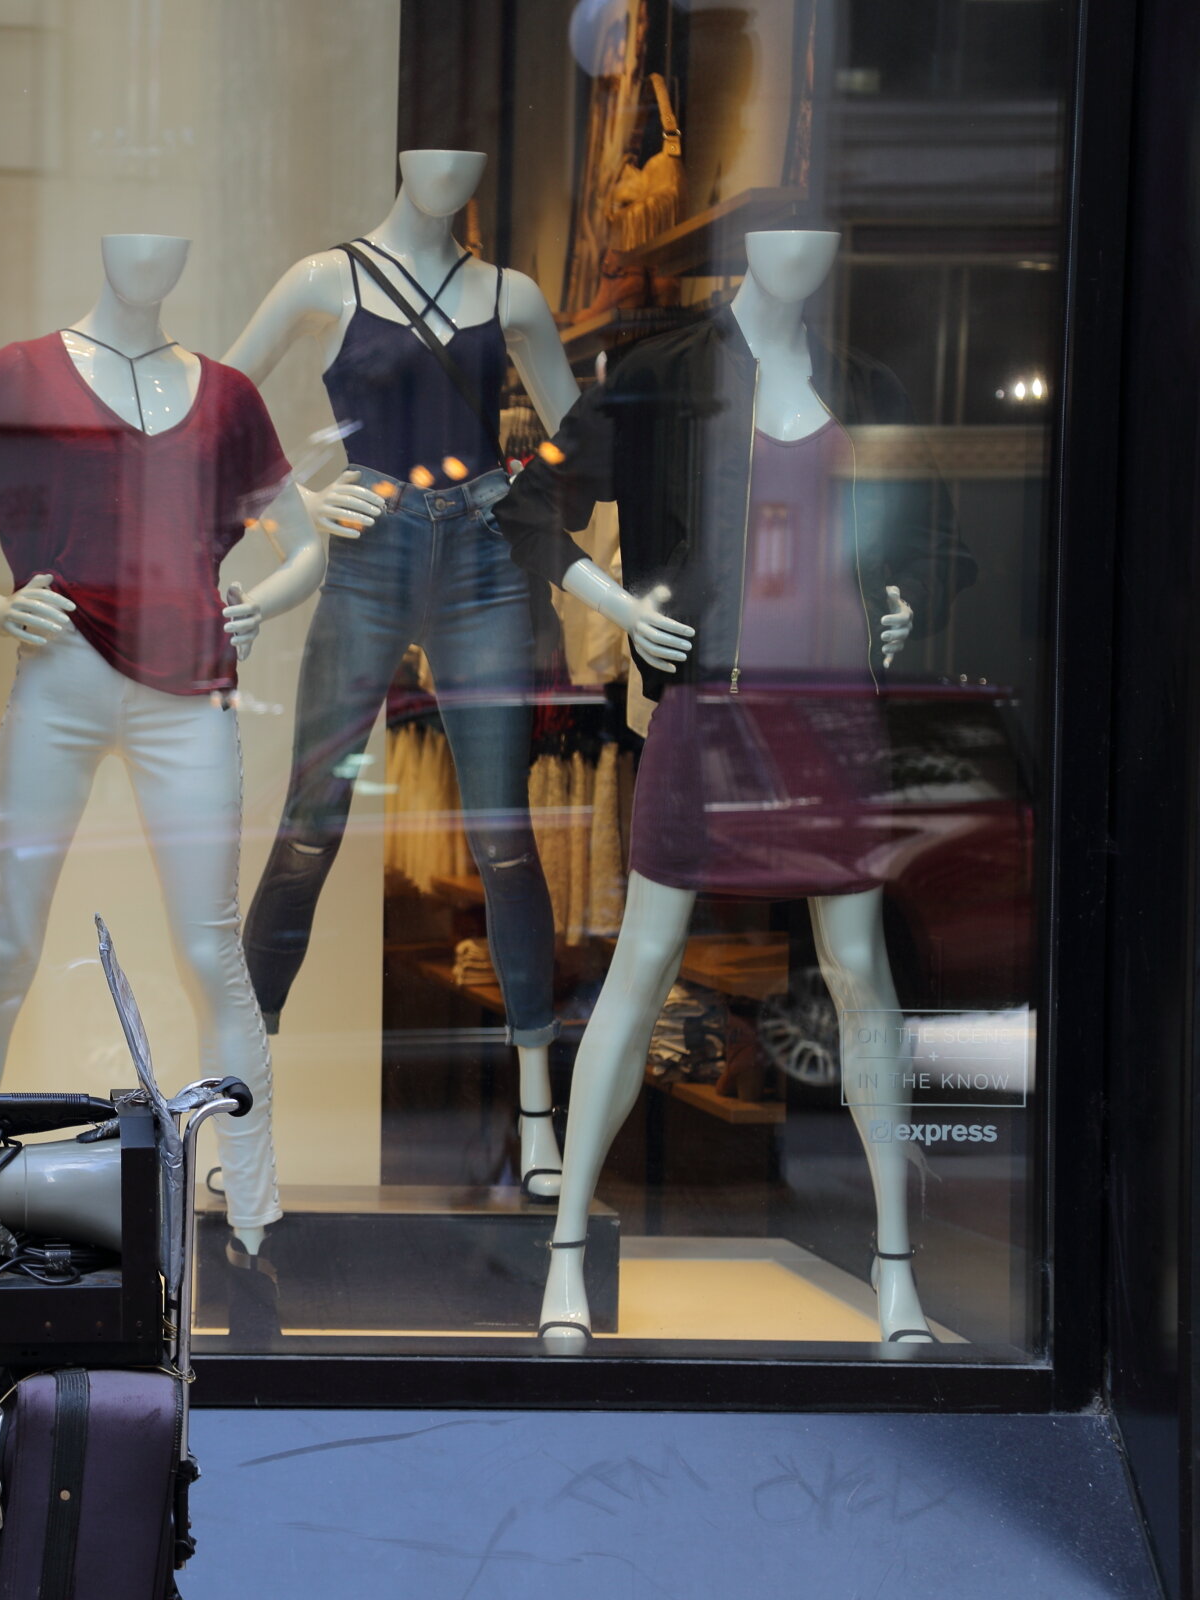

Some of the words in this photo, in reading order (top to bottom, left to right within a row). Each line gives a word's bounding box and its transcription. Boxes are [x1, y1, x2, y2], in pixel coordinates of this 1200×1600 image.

[857, 1028, 887, 1044] ON
[896, 1027, 935, 1044] THE
[943, 1028, 1012, 1045] SCENE
[858, 1073, 878, 1089] IN
[889, 1073, 931, 1089] THE
[941, 1073, 1010, 1090] KNOW
[895, 1123, 998, 1146] express
